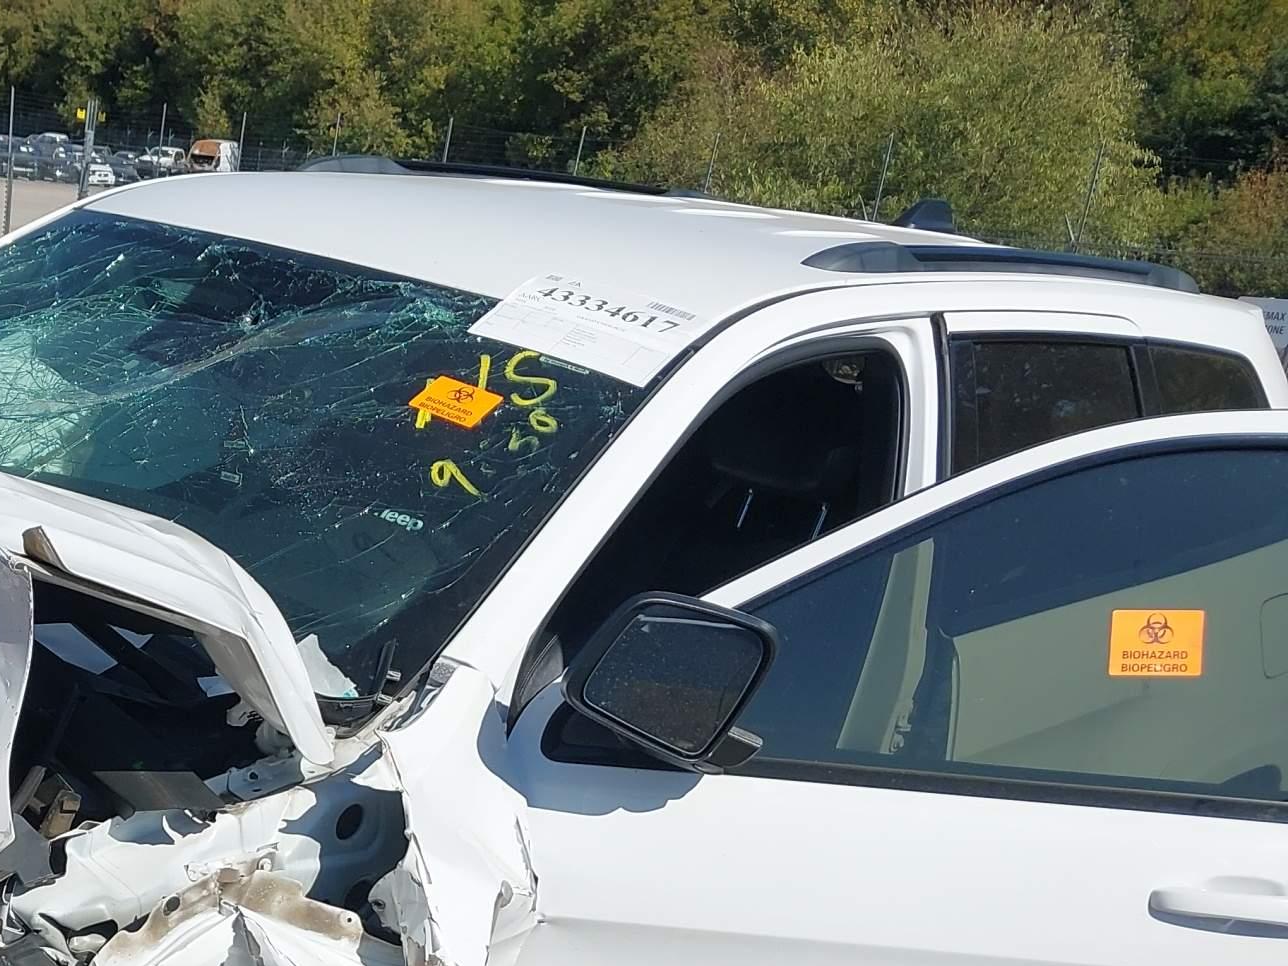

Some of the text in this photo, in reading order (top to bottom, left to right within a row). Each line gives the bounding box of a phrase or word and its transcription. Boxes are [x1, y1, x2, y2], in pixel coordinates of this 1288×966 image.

[537, 286, 679, 334] 43334617
[419, 401, 467, 423] BIOPELIGRO
[425, 396, 473, 418] BIOHAZARD
[1122, 650, 1188, 659] BIOHAZARD
